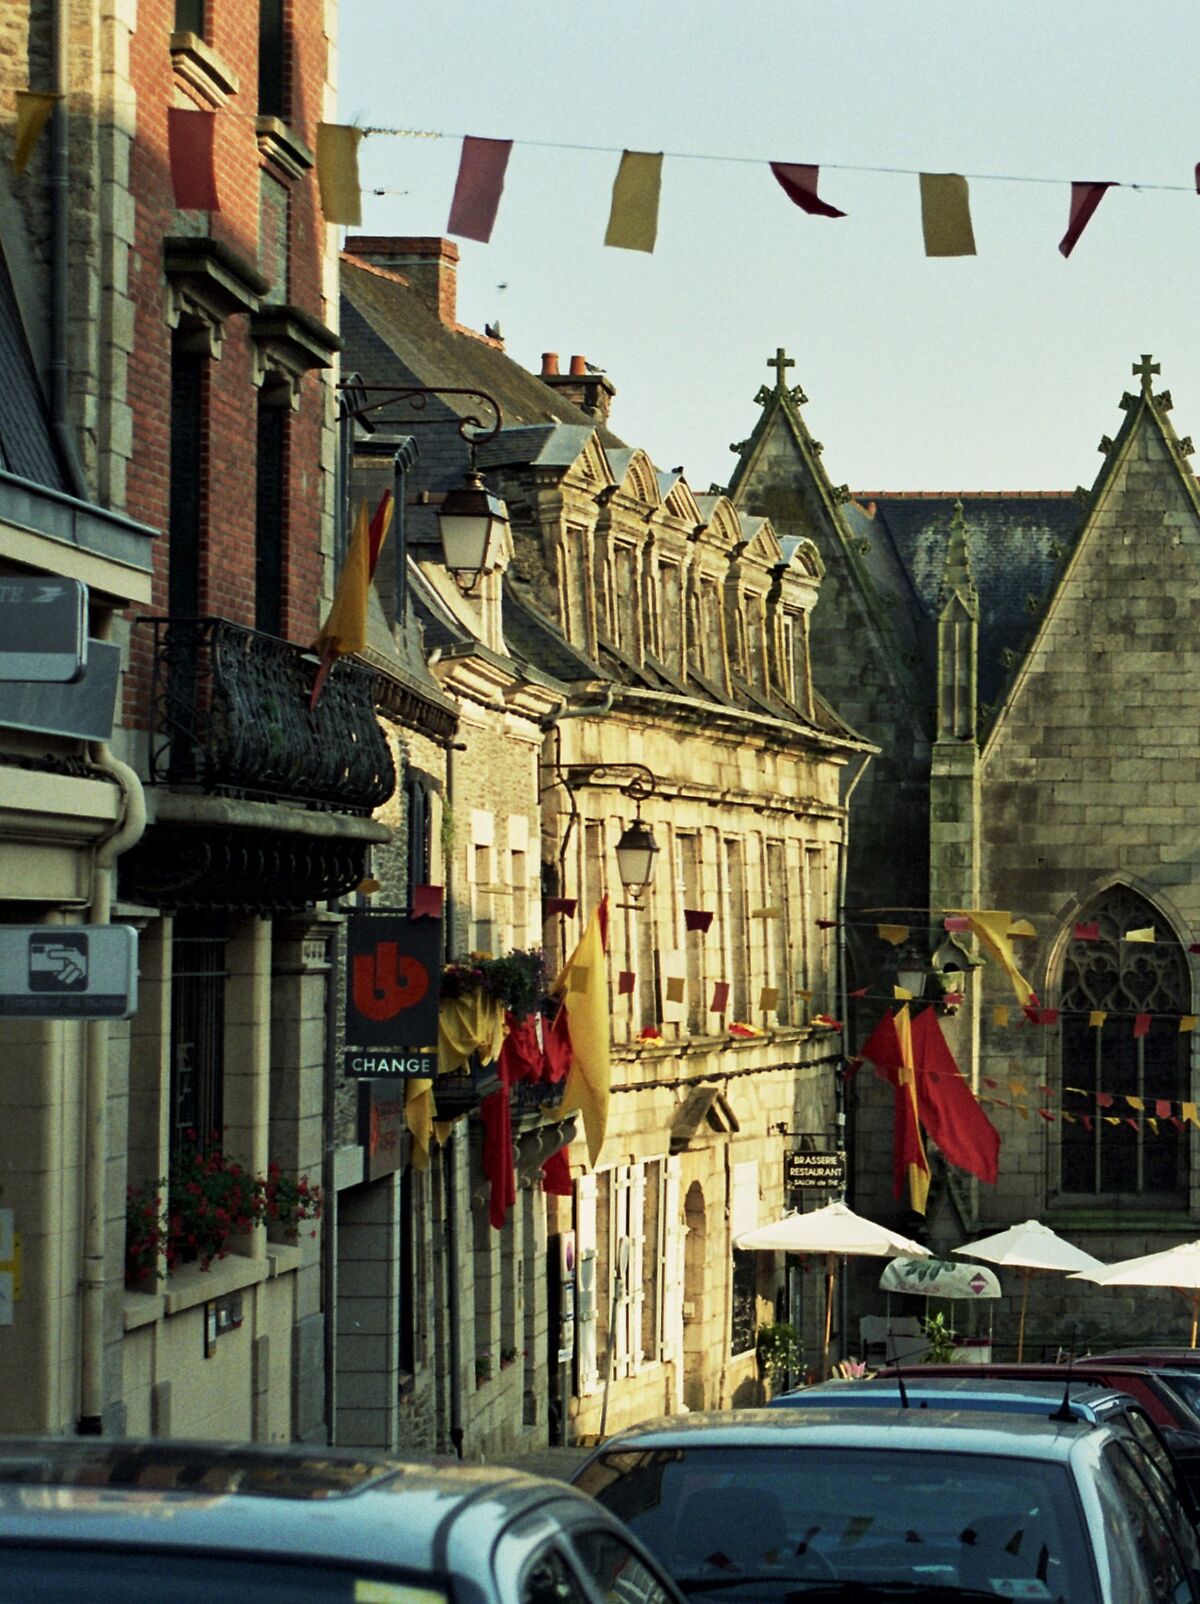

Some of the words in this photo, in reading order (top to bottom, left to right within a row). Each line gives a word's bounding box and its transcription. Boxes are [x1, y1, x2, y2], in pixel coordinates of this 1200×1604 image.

[352, 1057, 431, 1073] CHANGE
[794, 1155, 838, 1165] BRASSERIE
[789, 1167, 842, 1176] RESTAURANT
